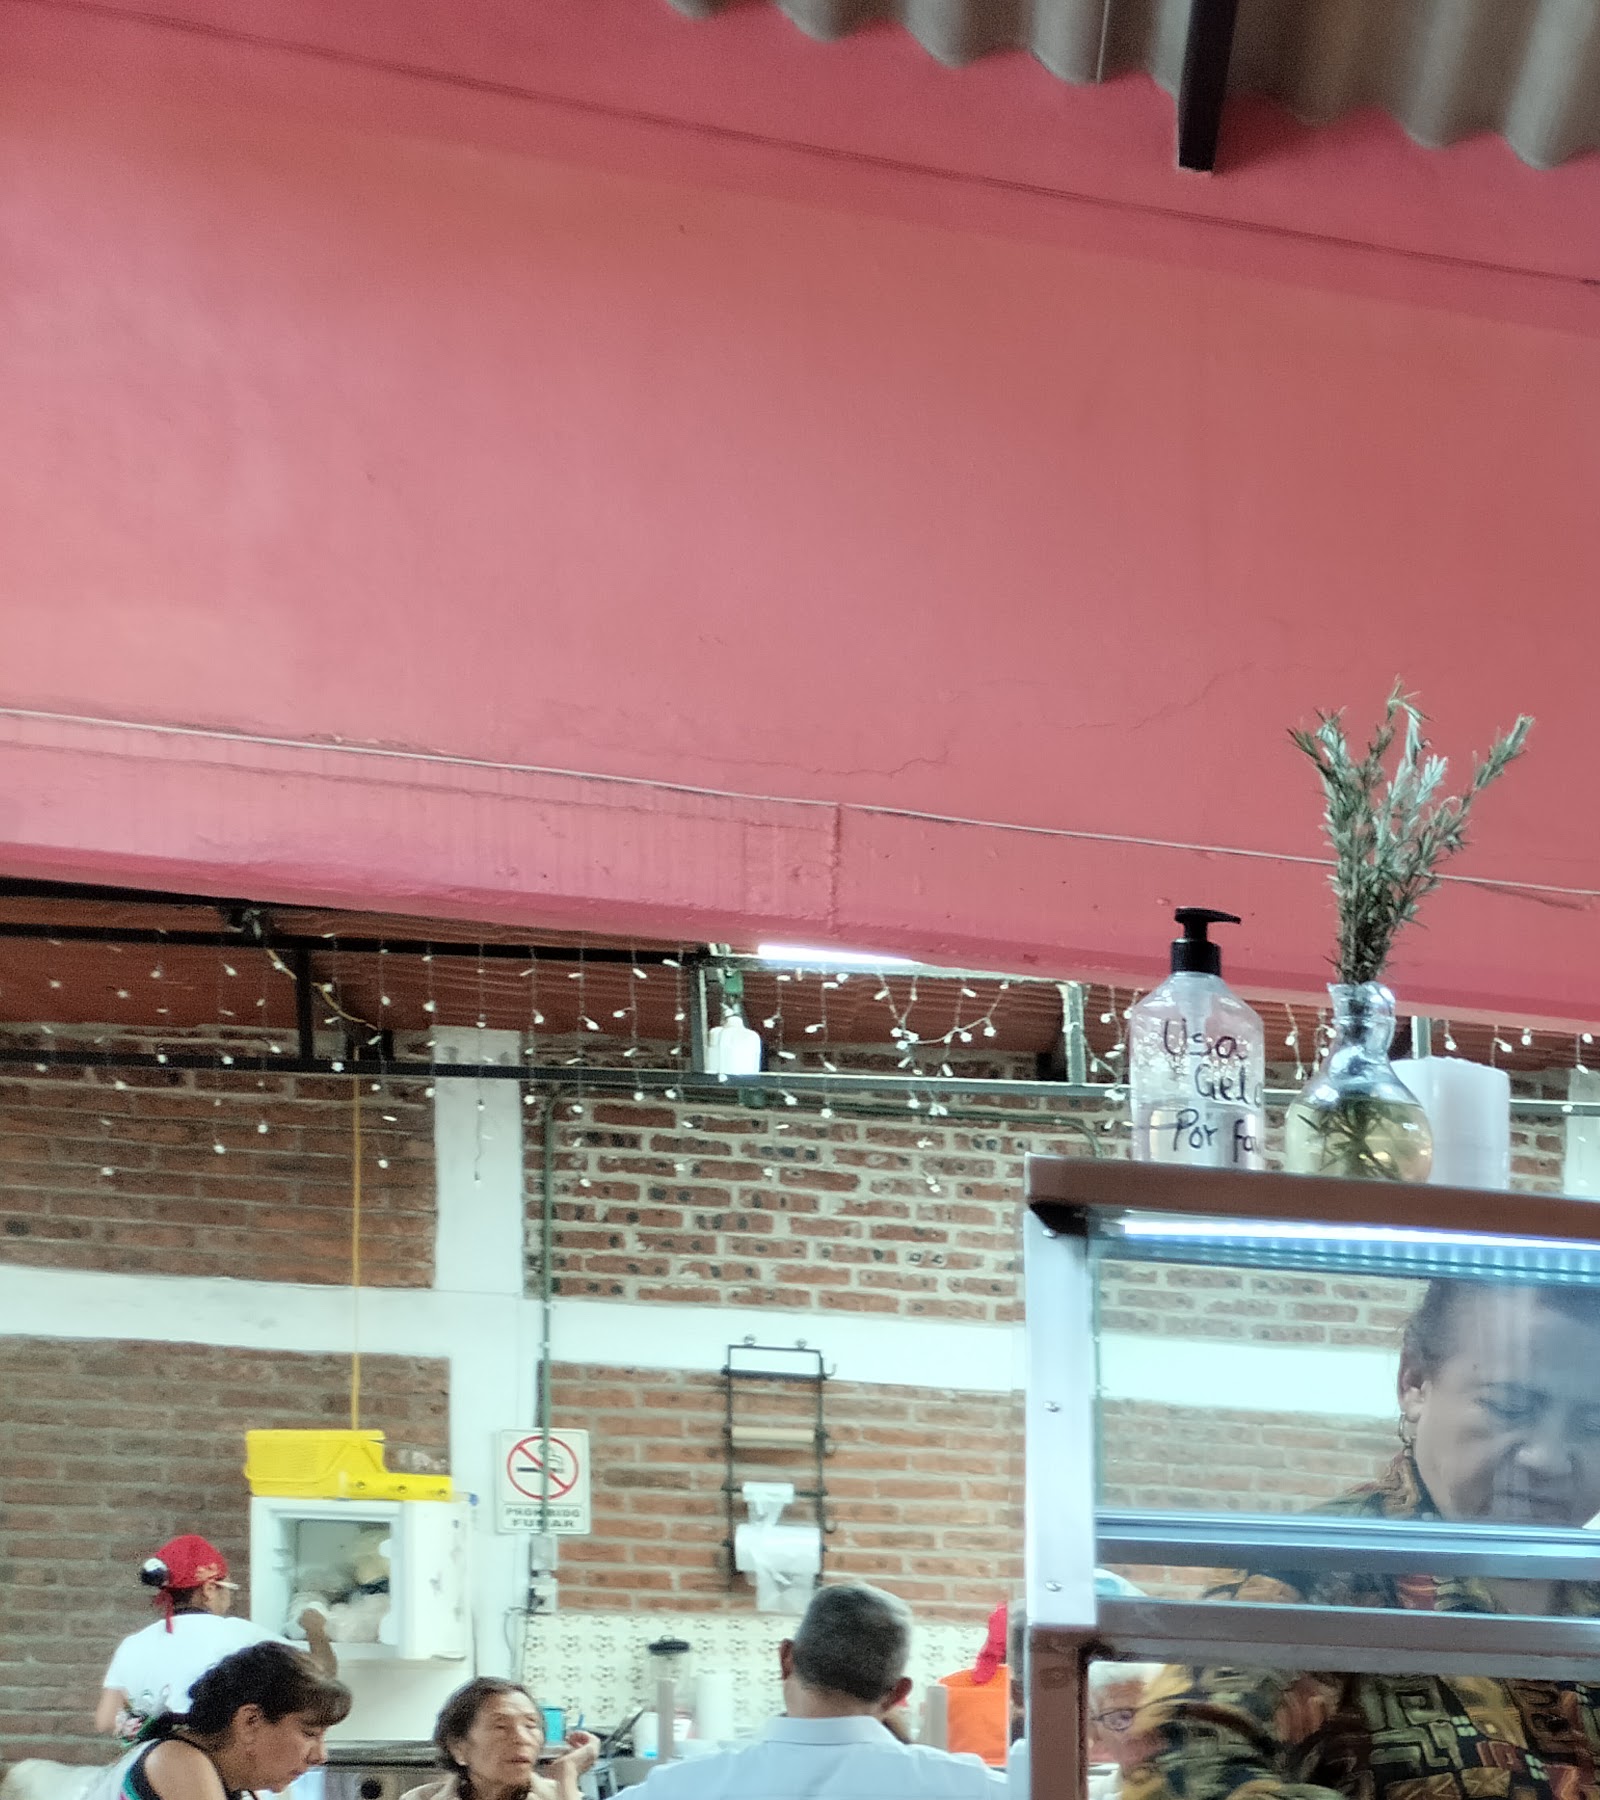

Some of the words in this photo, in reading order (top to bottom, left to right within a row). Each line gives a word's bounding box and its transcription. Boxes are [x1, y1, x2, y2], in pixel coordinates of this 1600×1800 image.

[1163, 1016, 1248, 1061] Usa
[1152, 1107, 1219, 1152] Por
[505, 1507, 581, 1518] PROHBIDO
